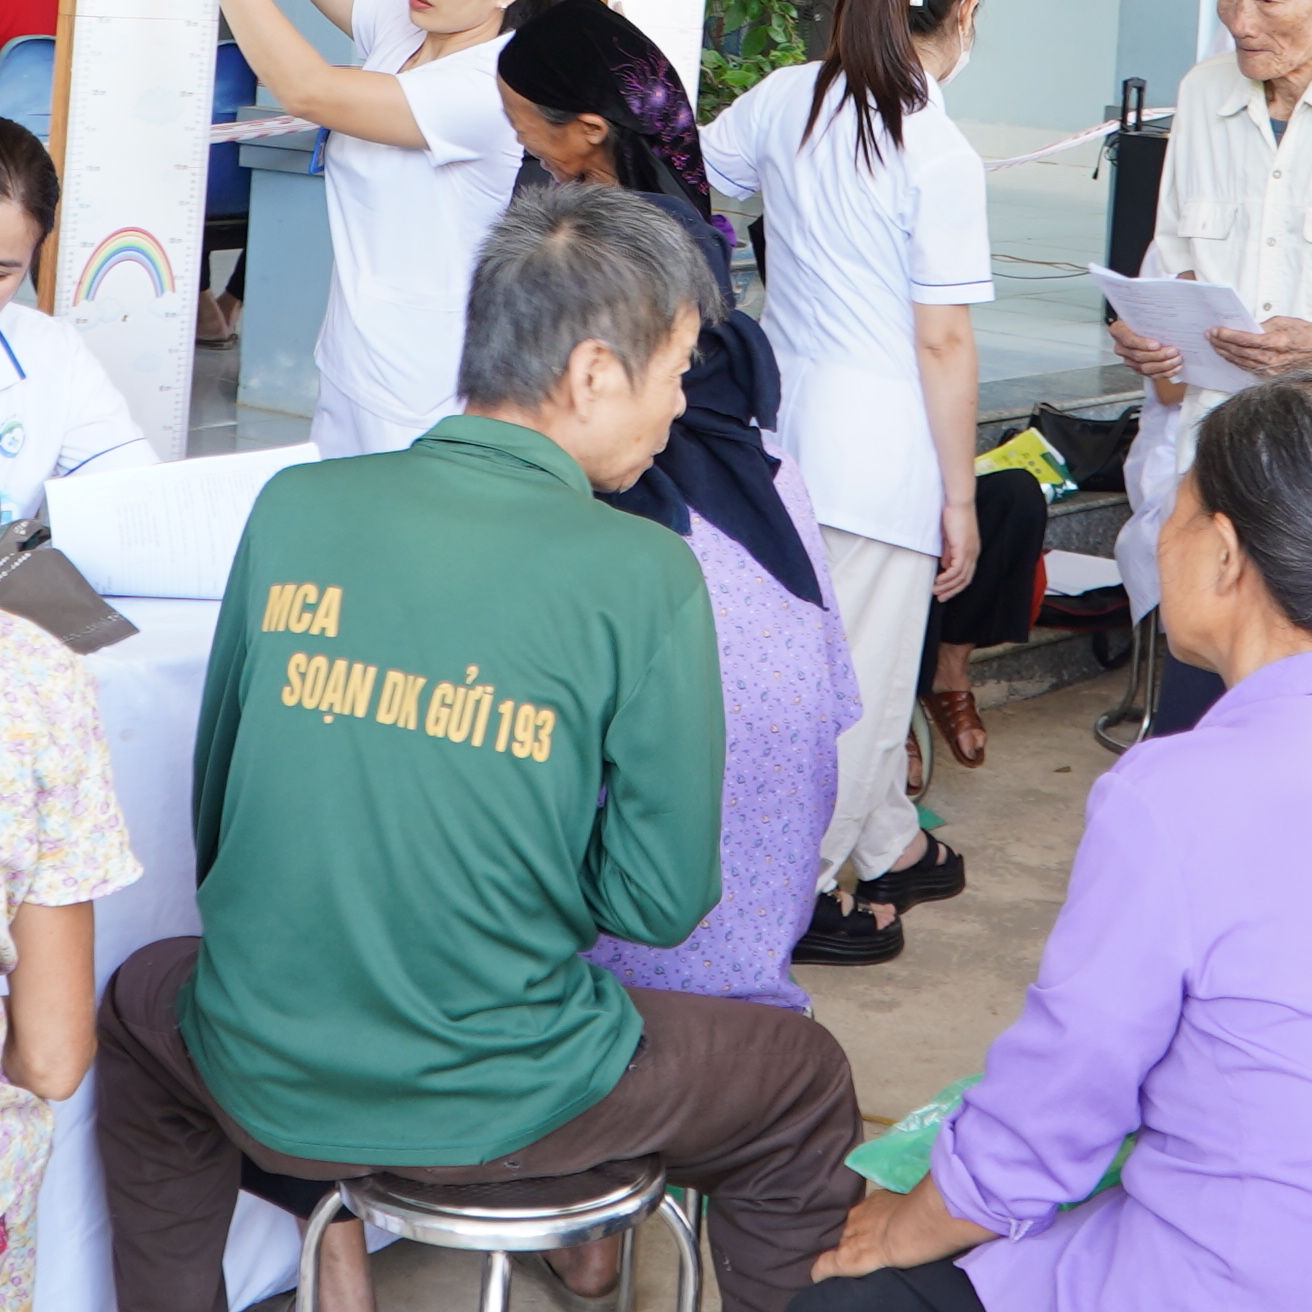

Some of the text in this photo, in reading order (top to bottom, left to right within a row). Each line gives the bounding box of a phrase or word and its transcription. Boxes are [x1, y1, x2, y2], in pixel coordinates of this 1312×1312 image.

[261, 581, 344, 638] MCA
[280, 651, 557, 764] SOẠN DK GỬI 193
